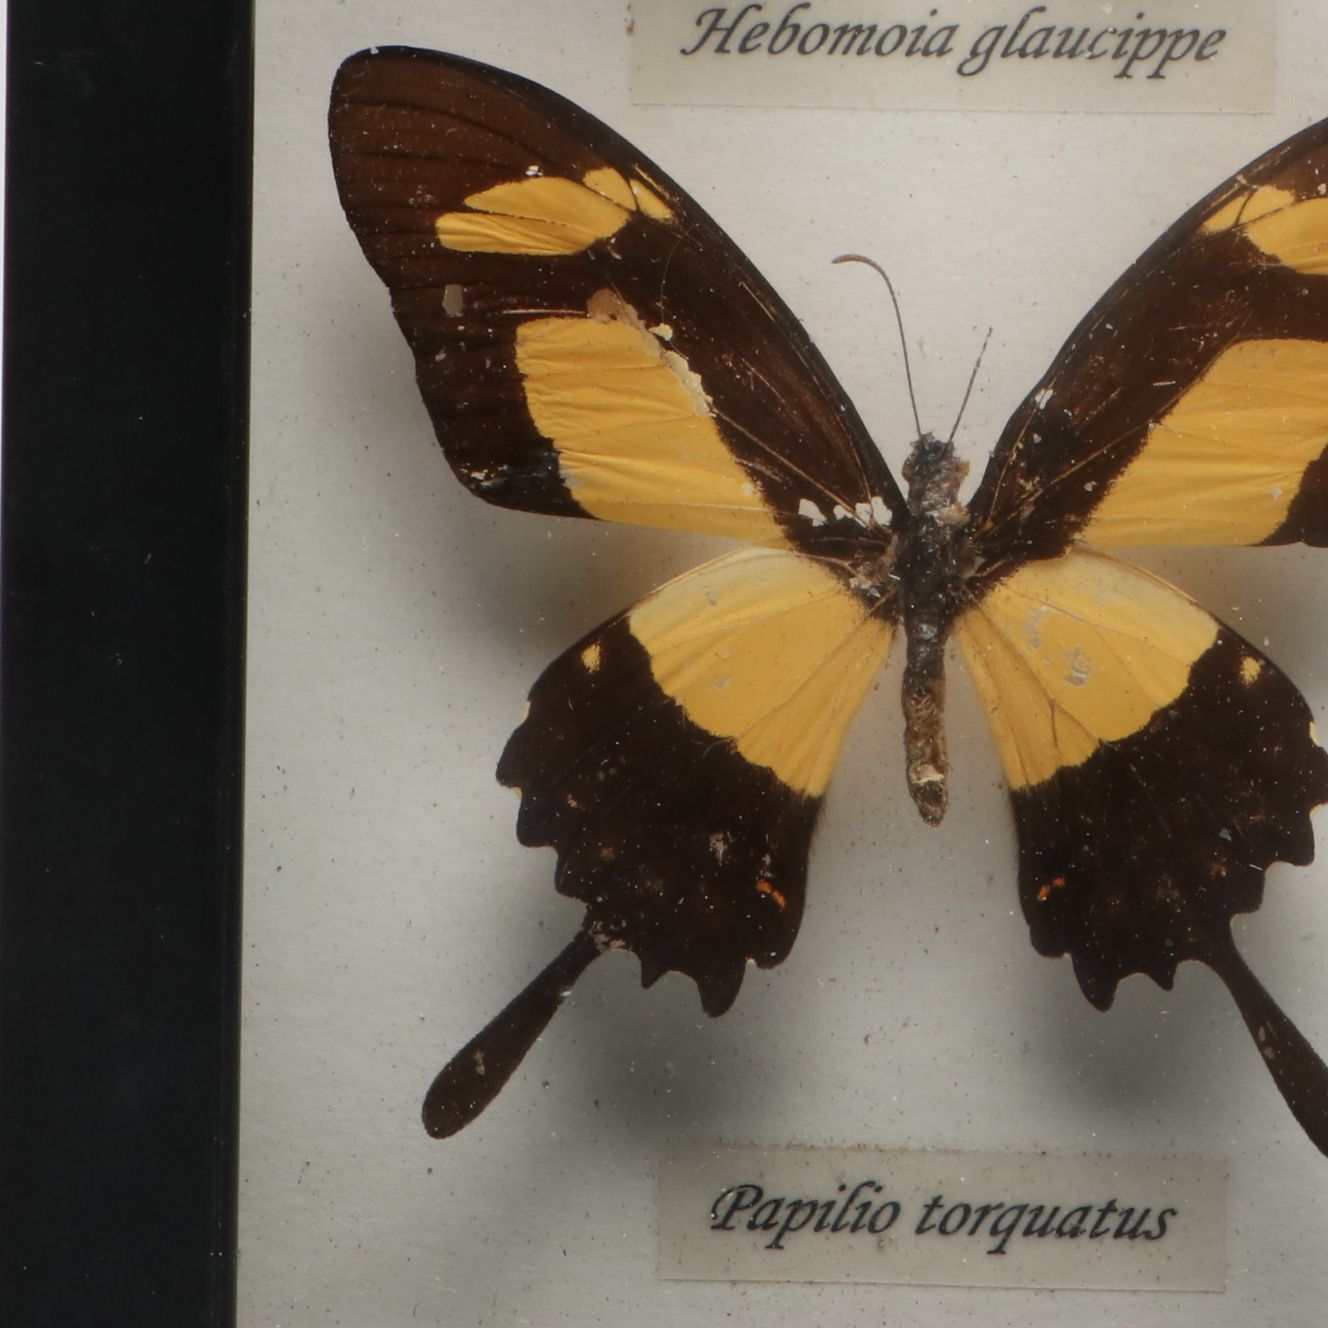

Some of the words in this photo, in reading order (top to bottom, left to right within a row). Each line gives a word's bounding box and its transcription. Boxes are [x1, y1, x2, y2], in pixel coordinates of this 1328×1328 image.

[680, 2, 959, 58] Hebomoia
[957, 5, 1227, 80] glaucippe
[710, 1180, 901, 1251] Papilio
[914, 1194, 1178, 1256] torquatus
